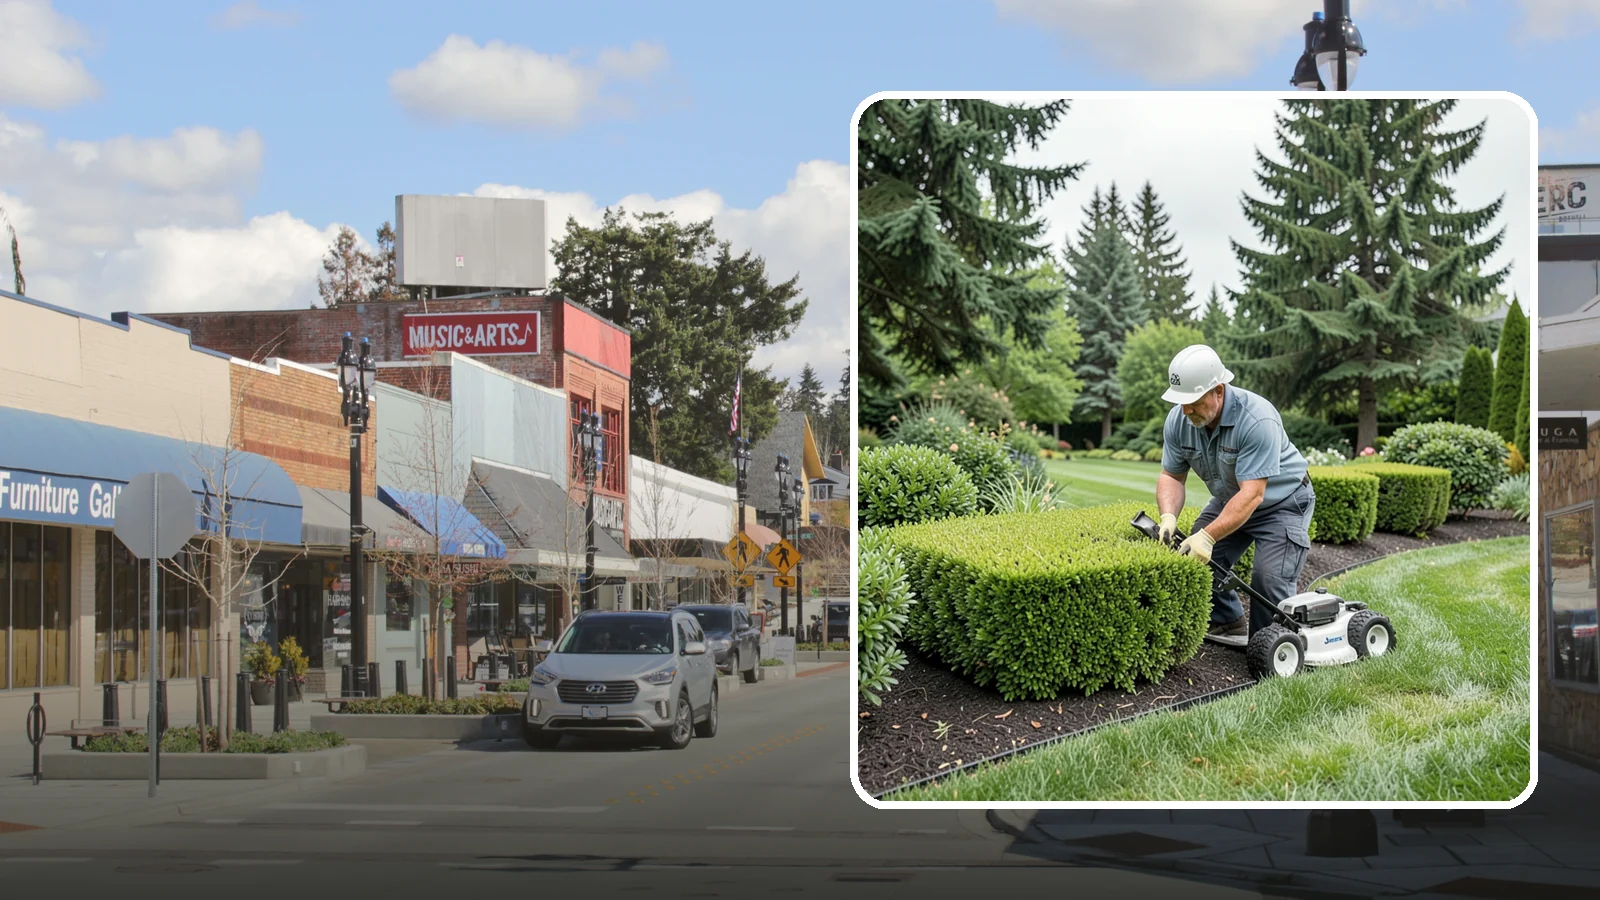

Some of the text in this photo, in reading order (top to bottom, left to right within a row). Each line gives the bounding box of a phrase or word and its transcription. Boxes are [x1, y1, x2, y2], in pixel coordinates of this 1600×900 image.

[408, 322, 520, 349] MUSIC&ARTS
[1540, 427, 1578, 437] UGA
[0, 471, 80, 516] Furniture
[453, 563, 480, 575] SUSHI
